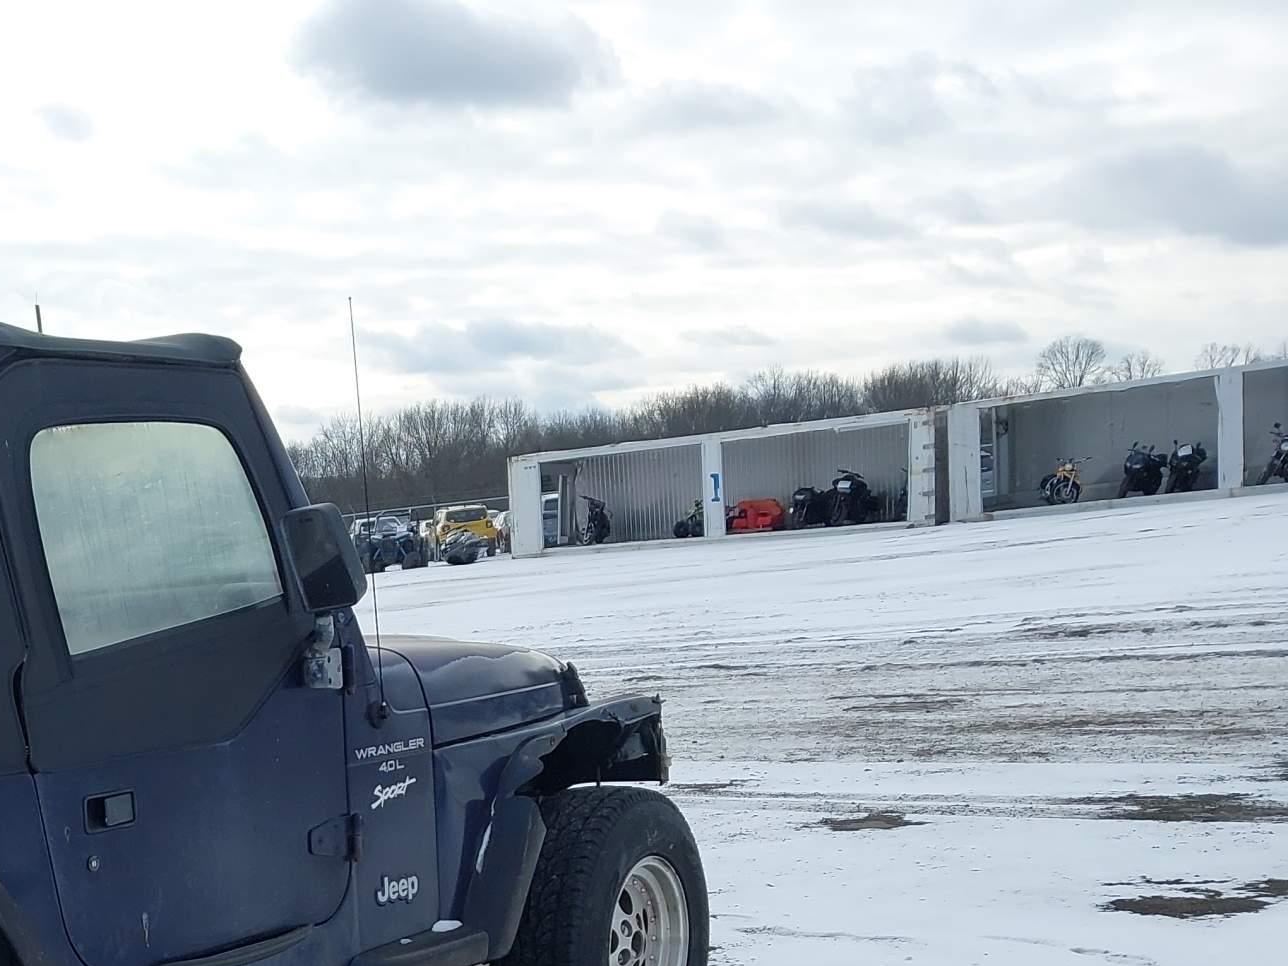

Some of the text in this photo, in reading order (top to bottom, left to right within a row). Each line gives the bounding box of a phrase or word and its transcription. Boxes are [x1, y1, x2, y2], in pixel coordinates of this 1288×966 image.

[710, 473, 720, 502] 1
[354, 738, 425, 760] WRANGLER
[370, 775, 416, 809] Sport
[376, 874, 419, 904] Jeep
